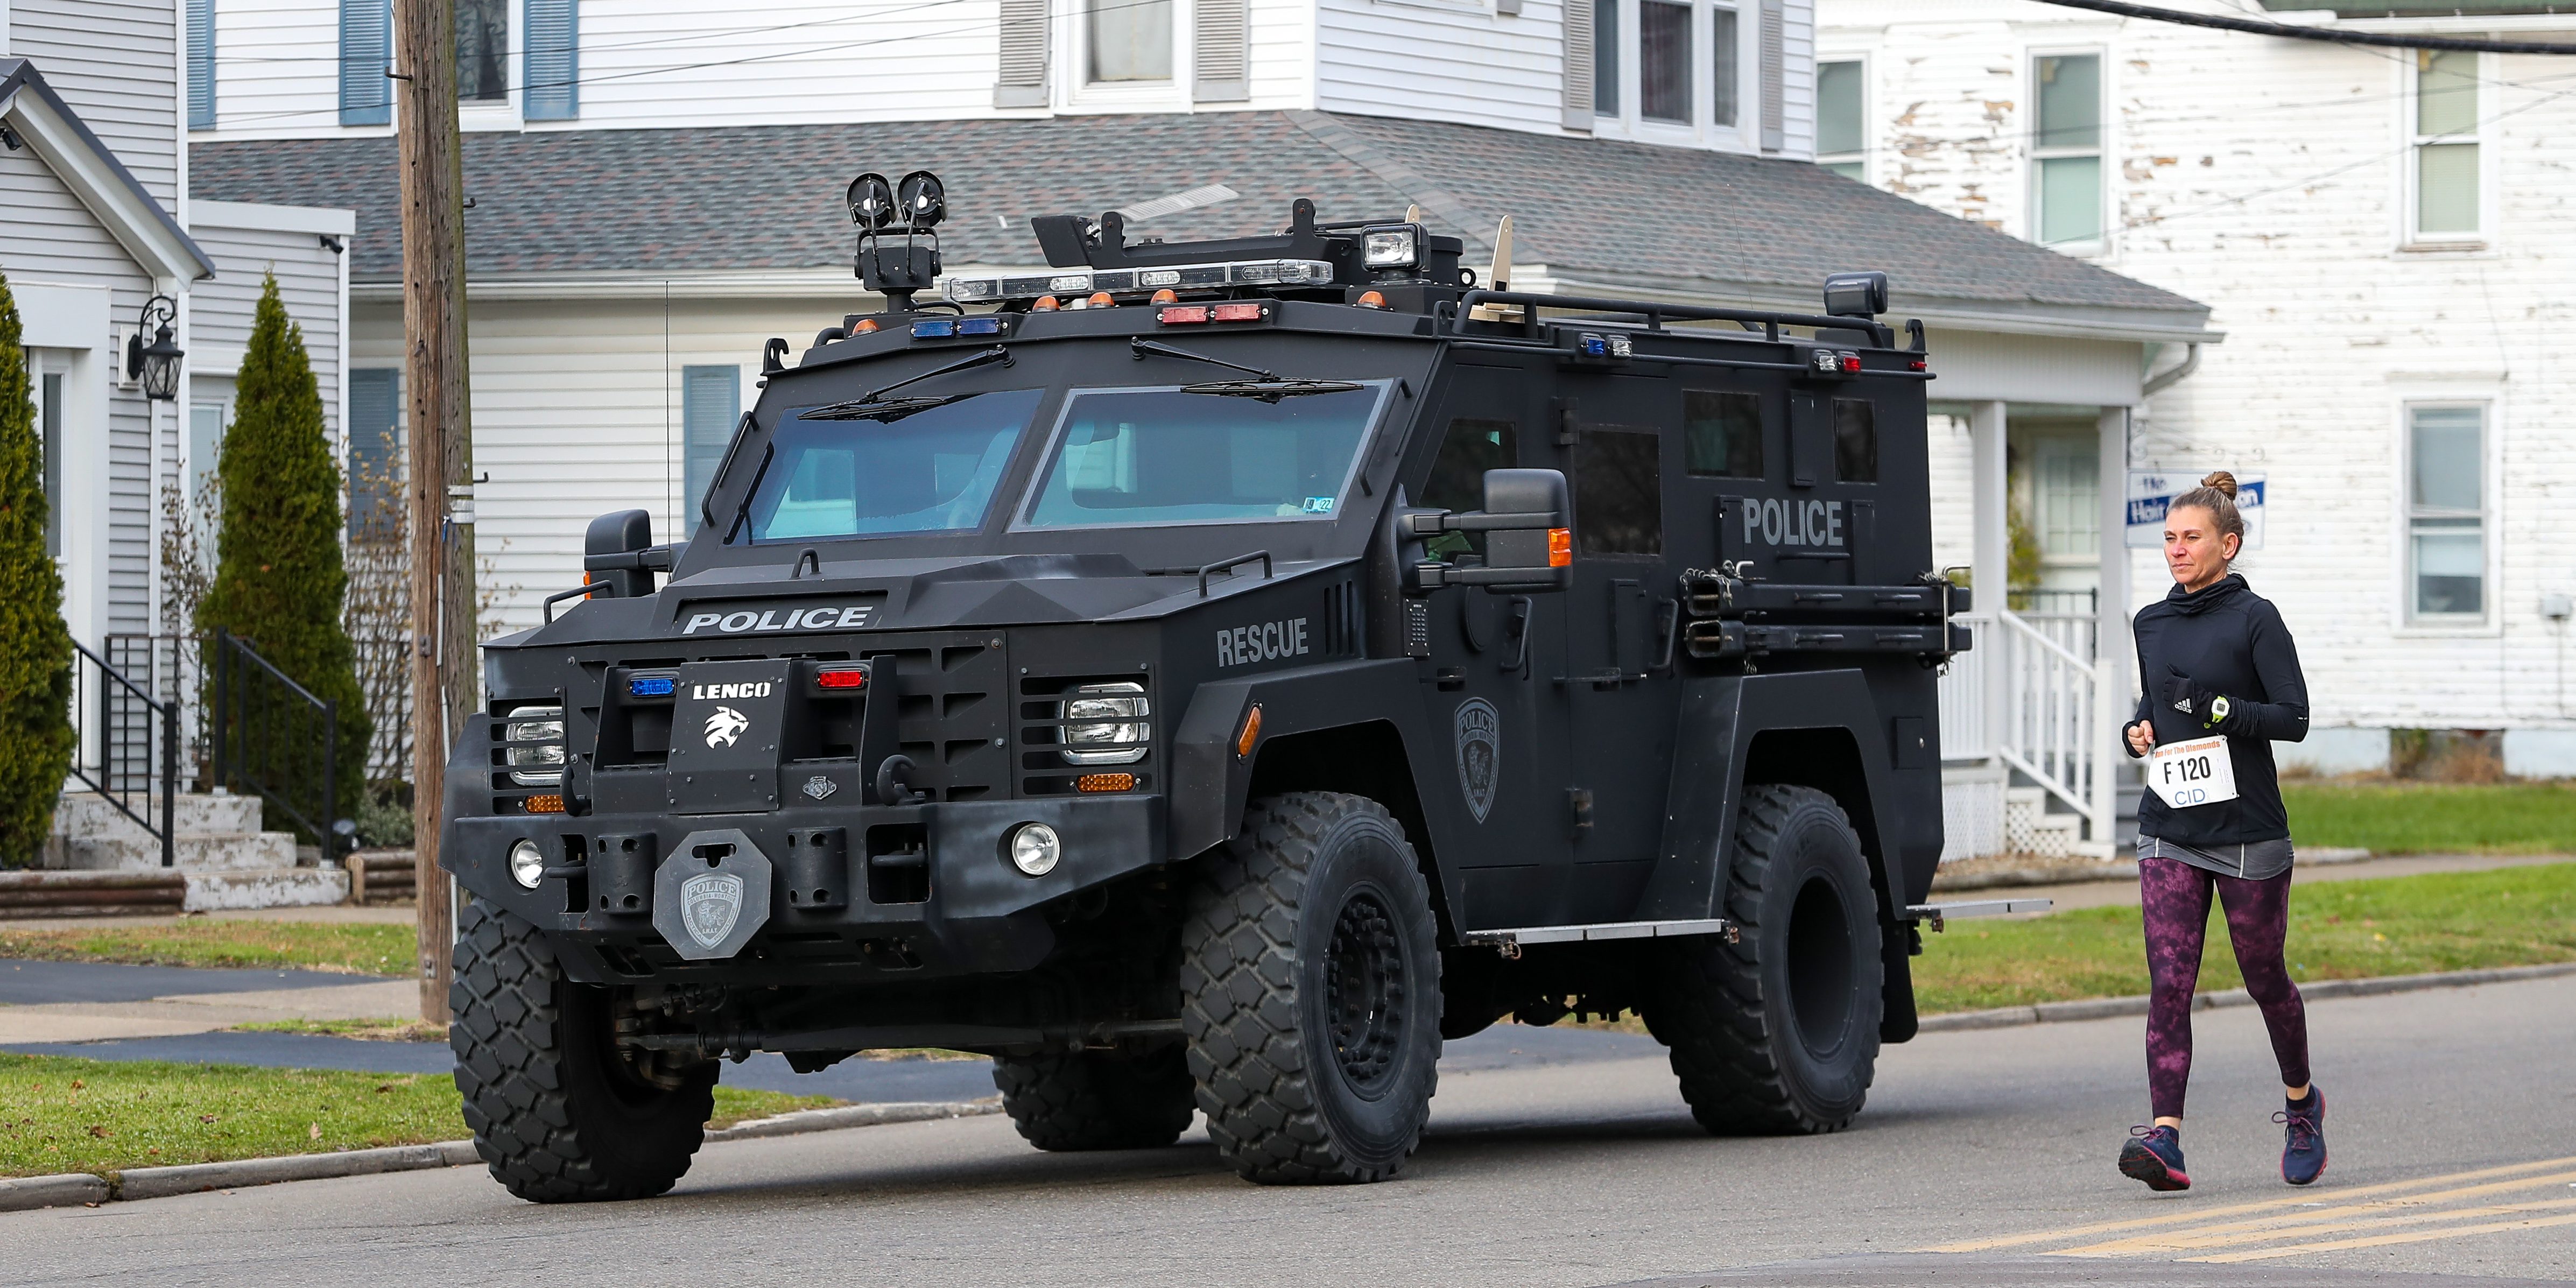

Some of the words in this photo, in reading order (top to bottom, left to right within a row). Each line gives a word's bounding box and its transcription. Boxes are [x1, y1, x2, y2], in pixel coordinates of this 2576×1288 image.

[1321, 499, 1331, 509] 22
[2131, 499, 2165, 524] Hair
[1743, 498, 1843, 546] POLICE
[682, 606, 874, 635] POLICE
[1217, 617, 1308, 667] RESCUE
[692, 682, 771, 700] LENCO
[2174, 703, 2192, 714] adidas
[1459, 711, 1495, 738] POLICE
[2185, 741, 2221, 752] Diamonds
[2164, 762, 2171, 784] F
[2178, 756, 2211, 782] 120
[2175, 789, 2205, 805] CID
[688, 881, 736, 899] POLICE
[686, 912, 705, 941] TACTICAL
